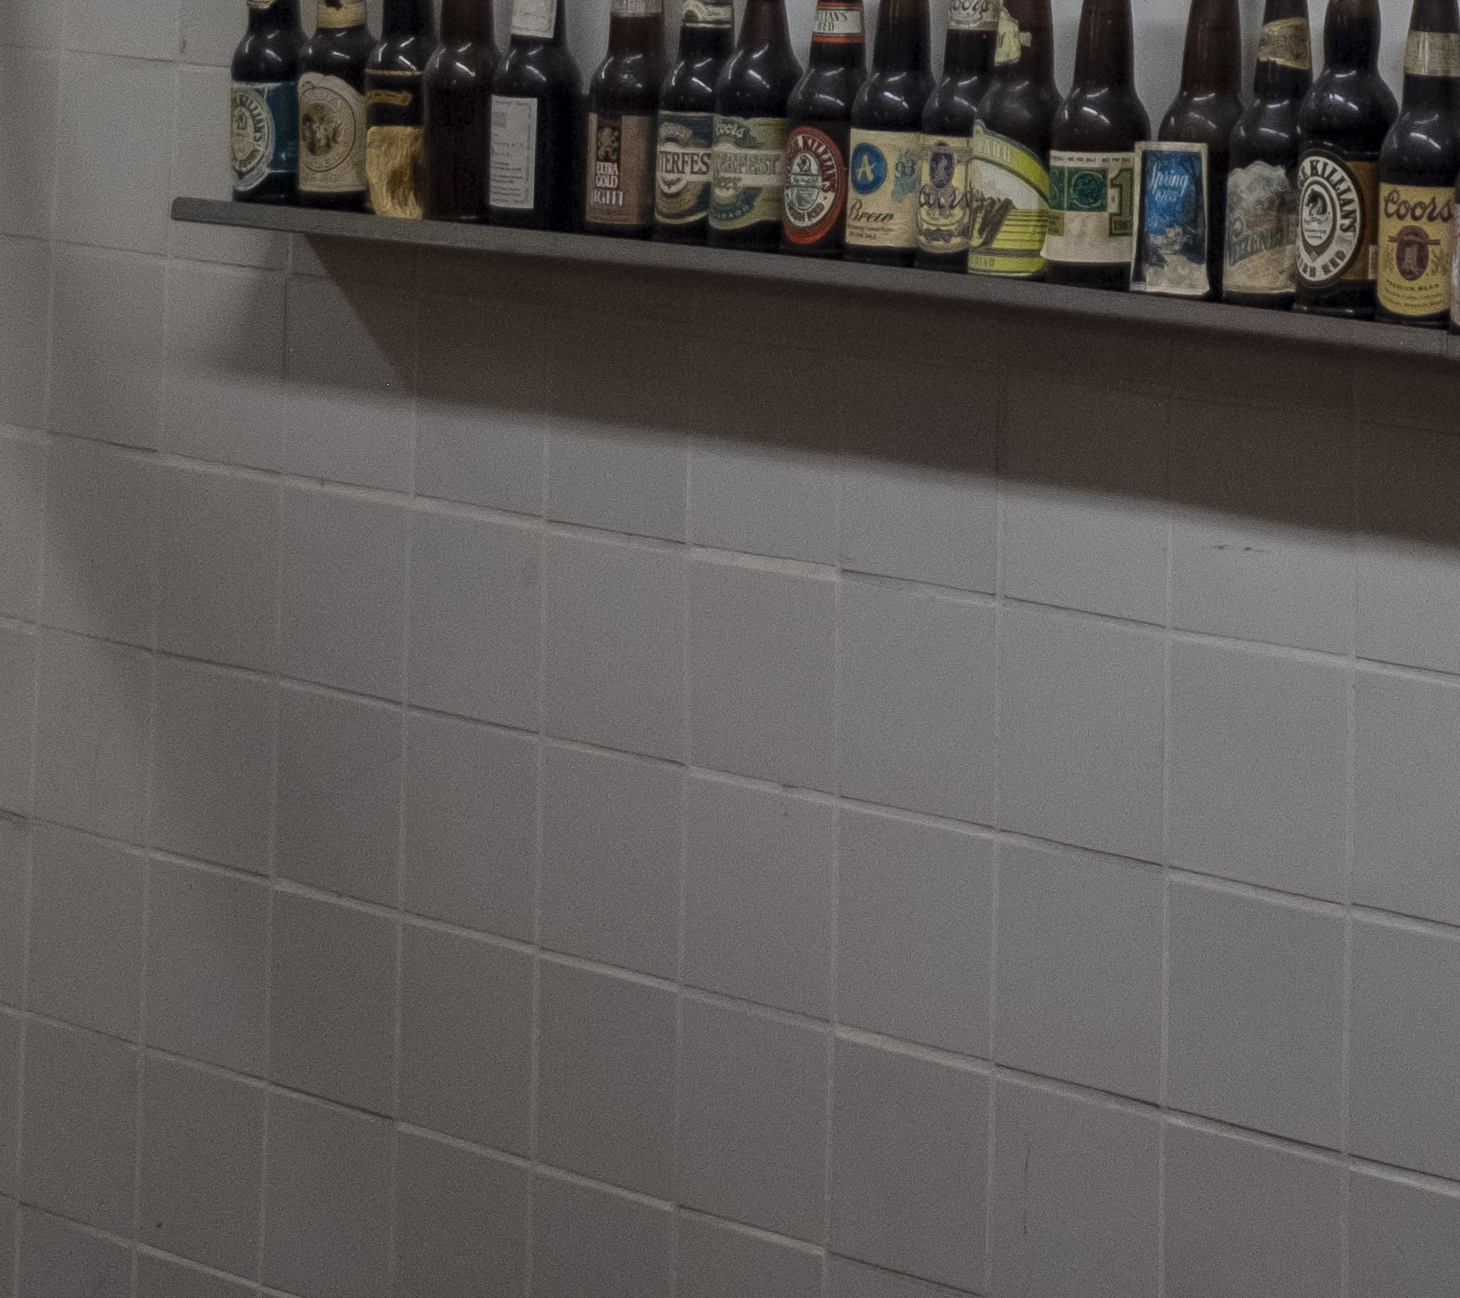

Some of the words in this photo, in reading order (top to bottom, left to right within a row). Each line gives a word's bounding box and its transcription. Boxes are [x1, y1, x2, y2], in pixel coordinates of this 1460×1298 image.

[592, 188, 624, 207] IGHT
[1383, 188, 1455, 223] Coors
[846, 198, 897, 225] Brew
